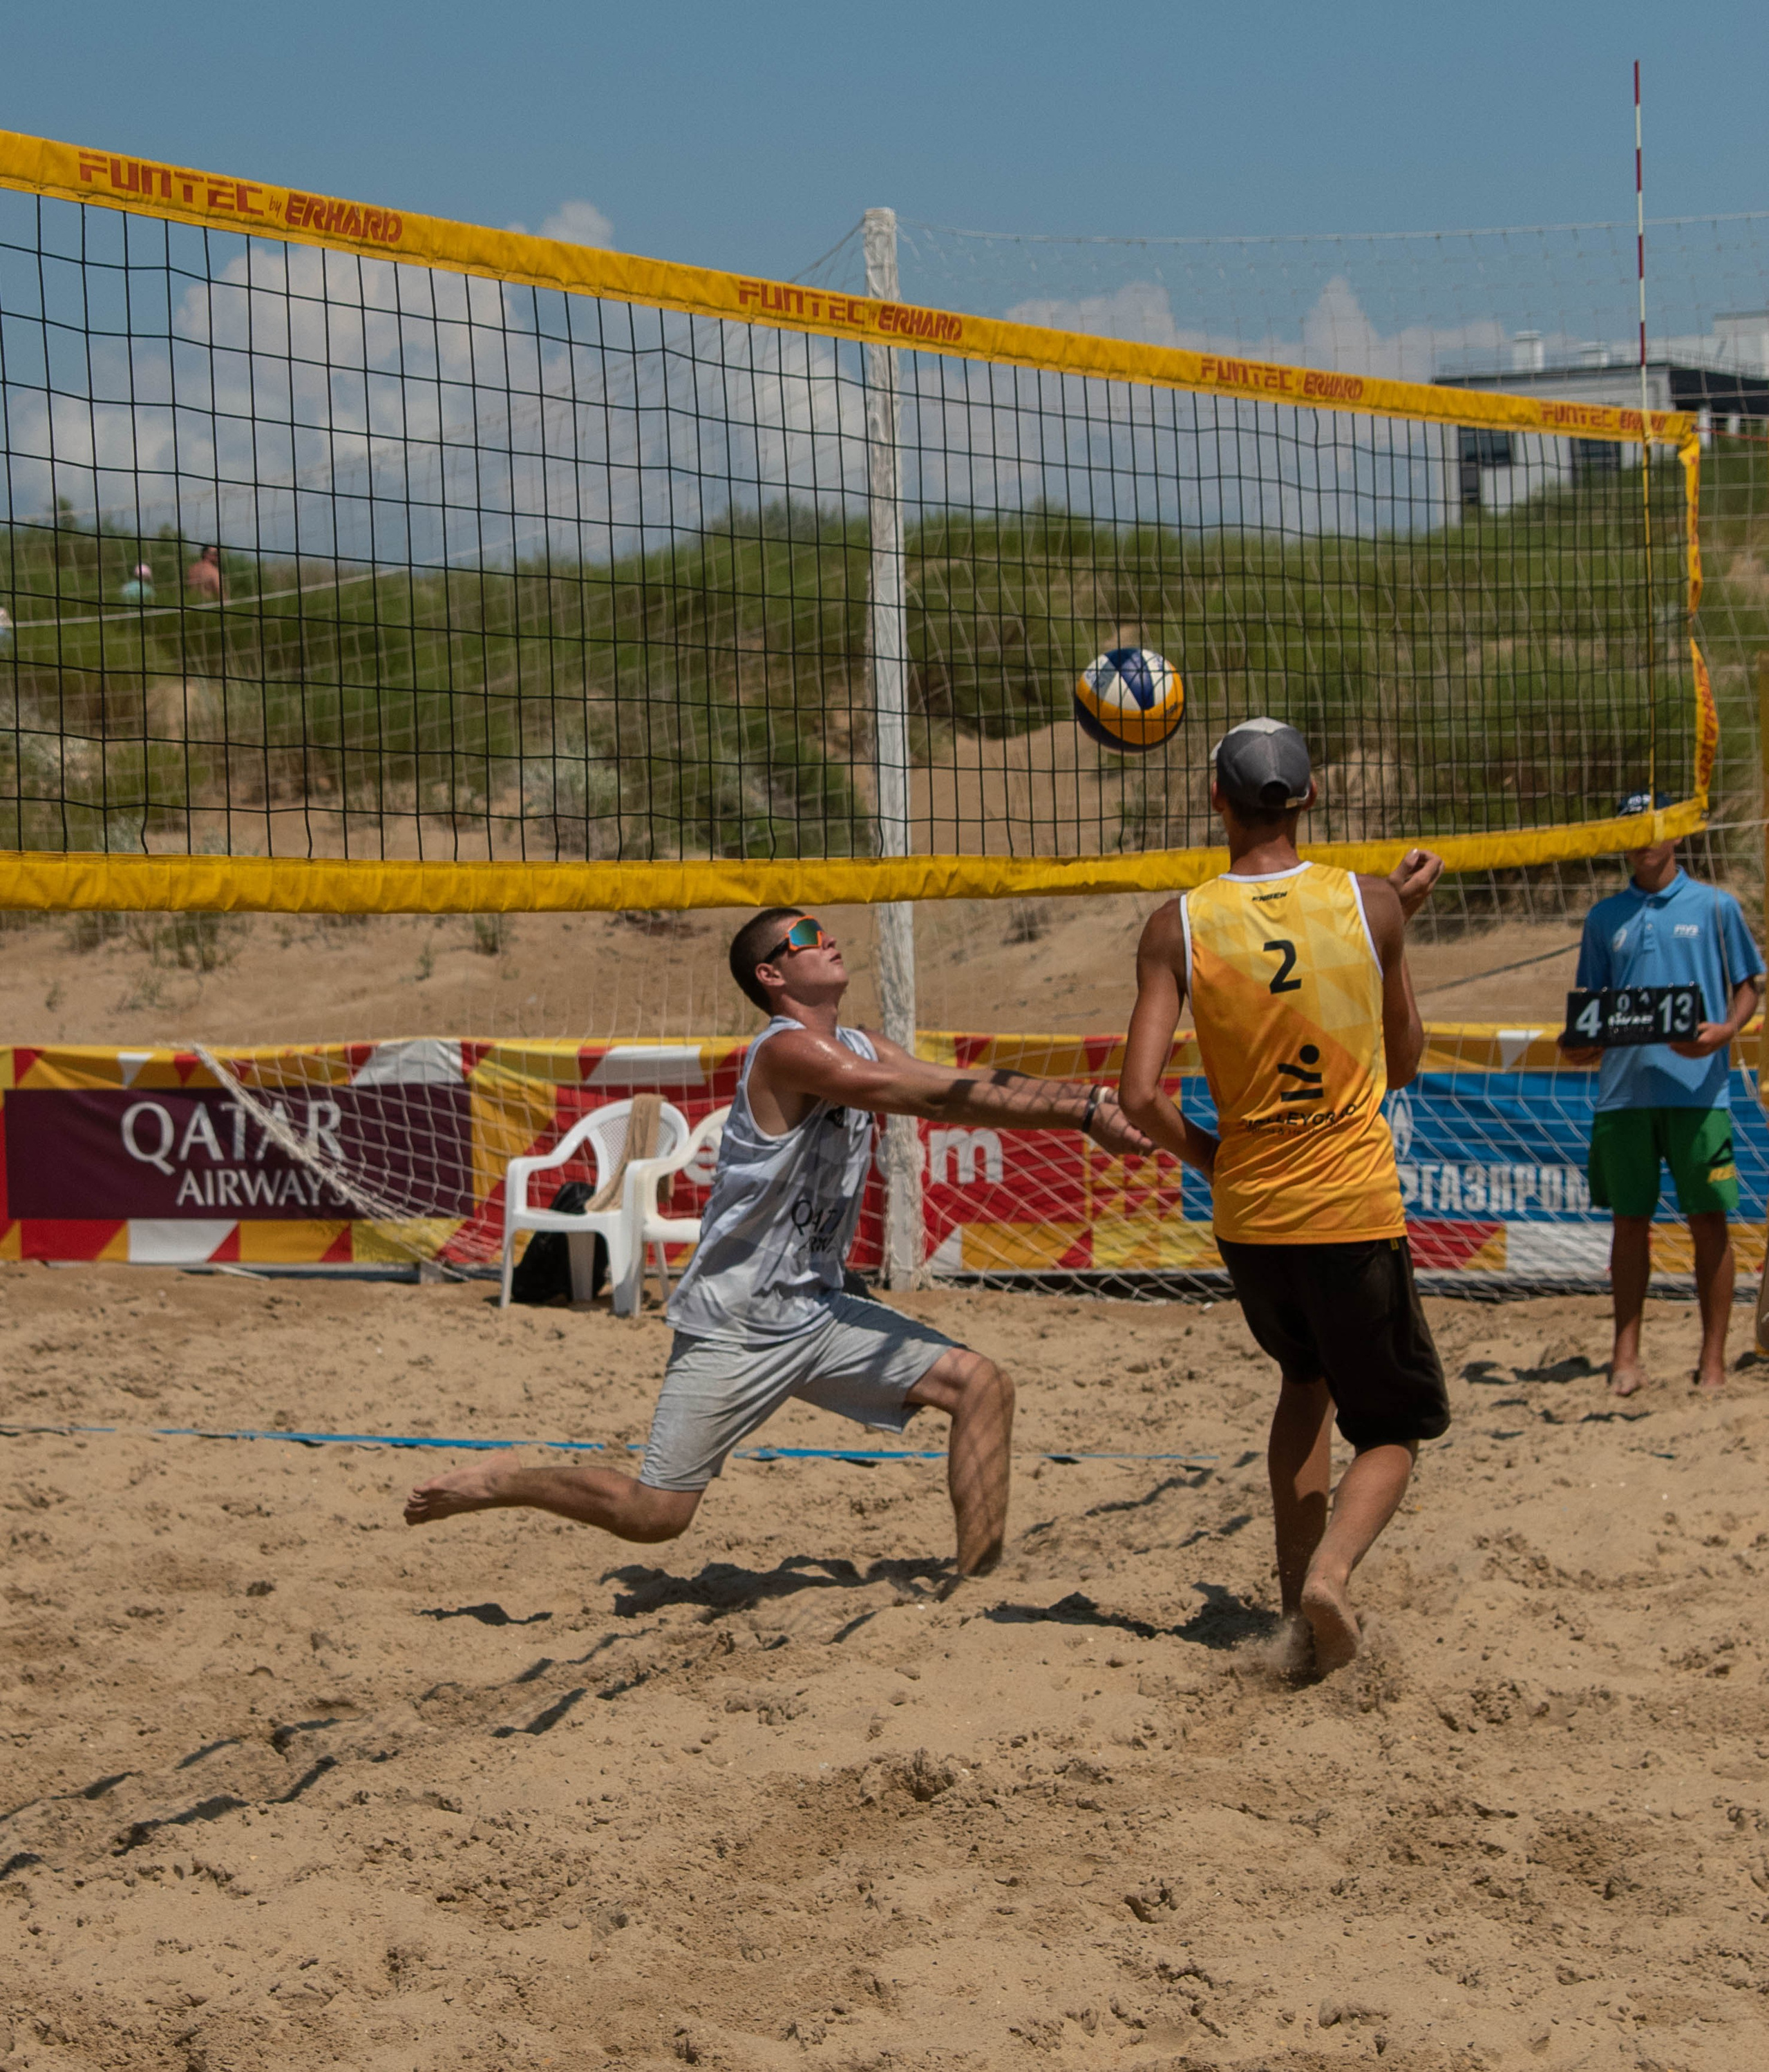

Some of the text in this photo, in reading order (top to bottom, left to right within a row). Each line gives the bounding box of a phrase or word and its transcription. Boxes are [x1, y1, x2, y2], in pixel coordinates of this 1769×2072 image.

[79, 151, 402, 243] FUNTEC by ERHARD
[739, 281, 864, 324] FUNTEC
[878, 305, 963, 341] ERHARD
[1201, 359, 1363, 400] FUNTEC ERHARD
[1541, 402, 1613, 428] FUNTEC
[1263, 940, 1302, 994] 2
[1576, 999, 1602, 1037] 4
[1617, 994, 1630, 1011] 0
[1658, 992, 1693, 1033] 13
[120, 1101, 346, 1175] QATAR
